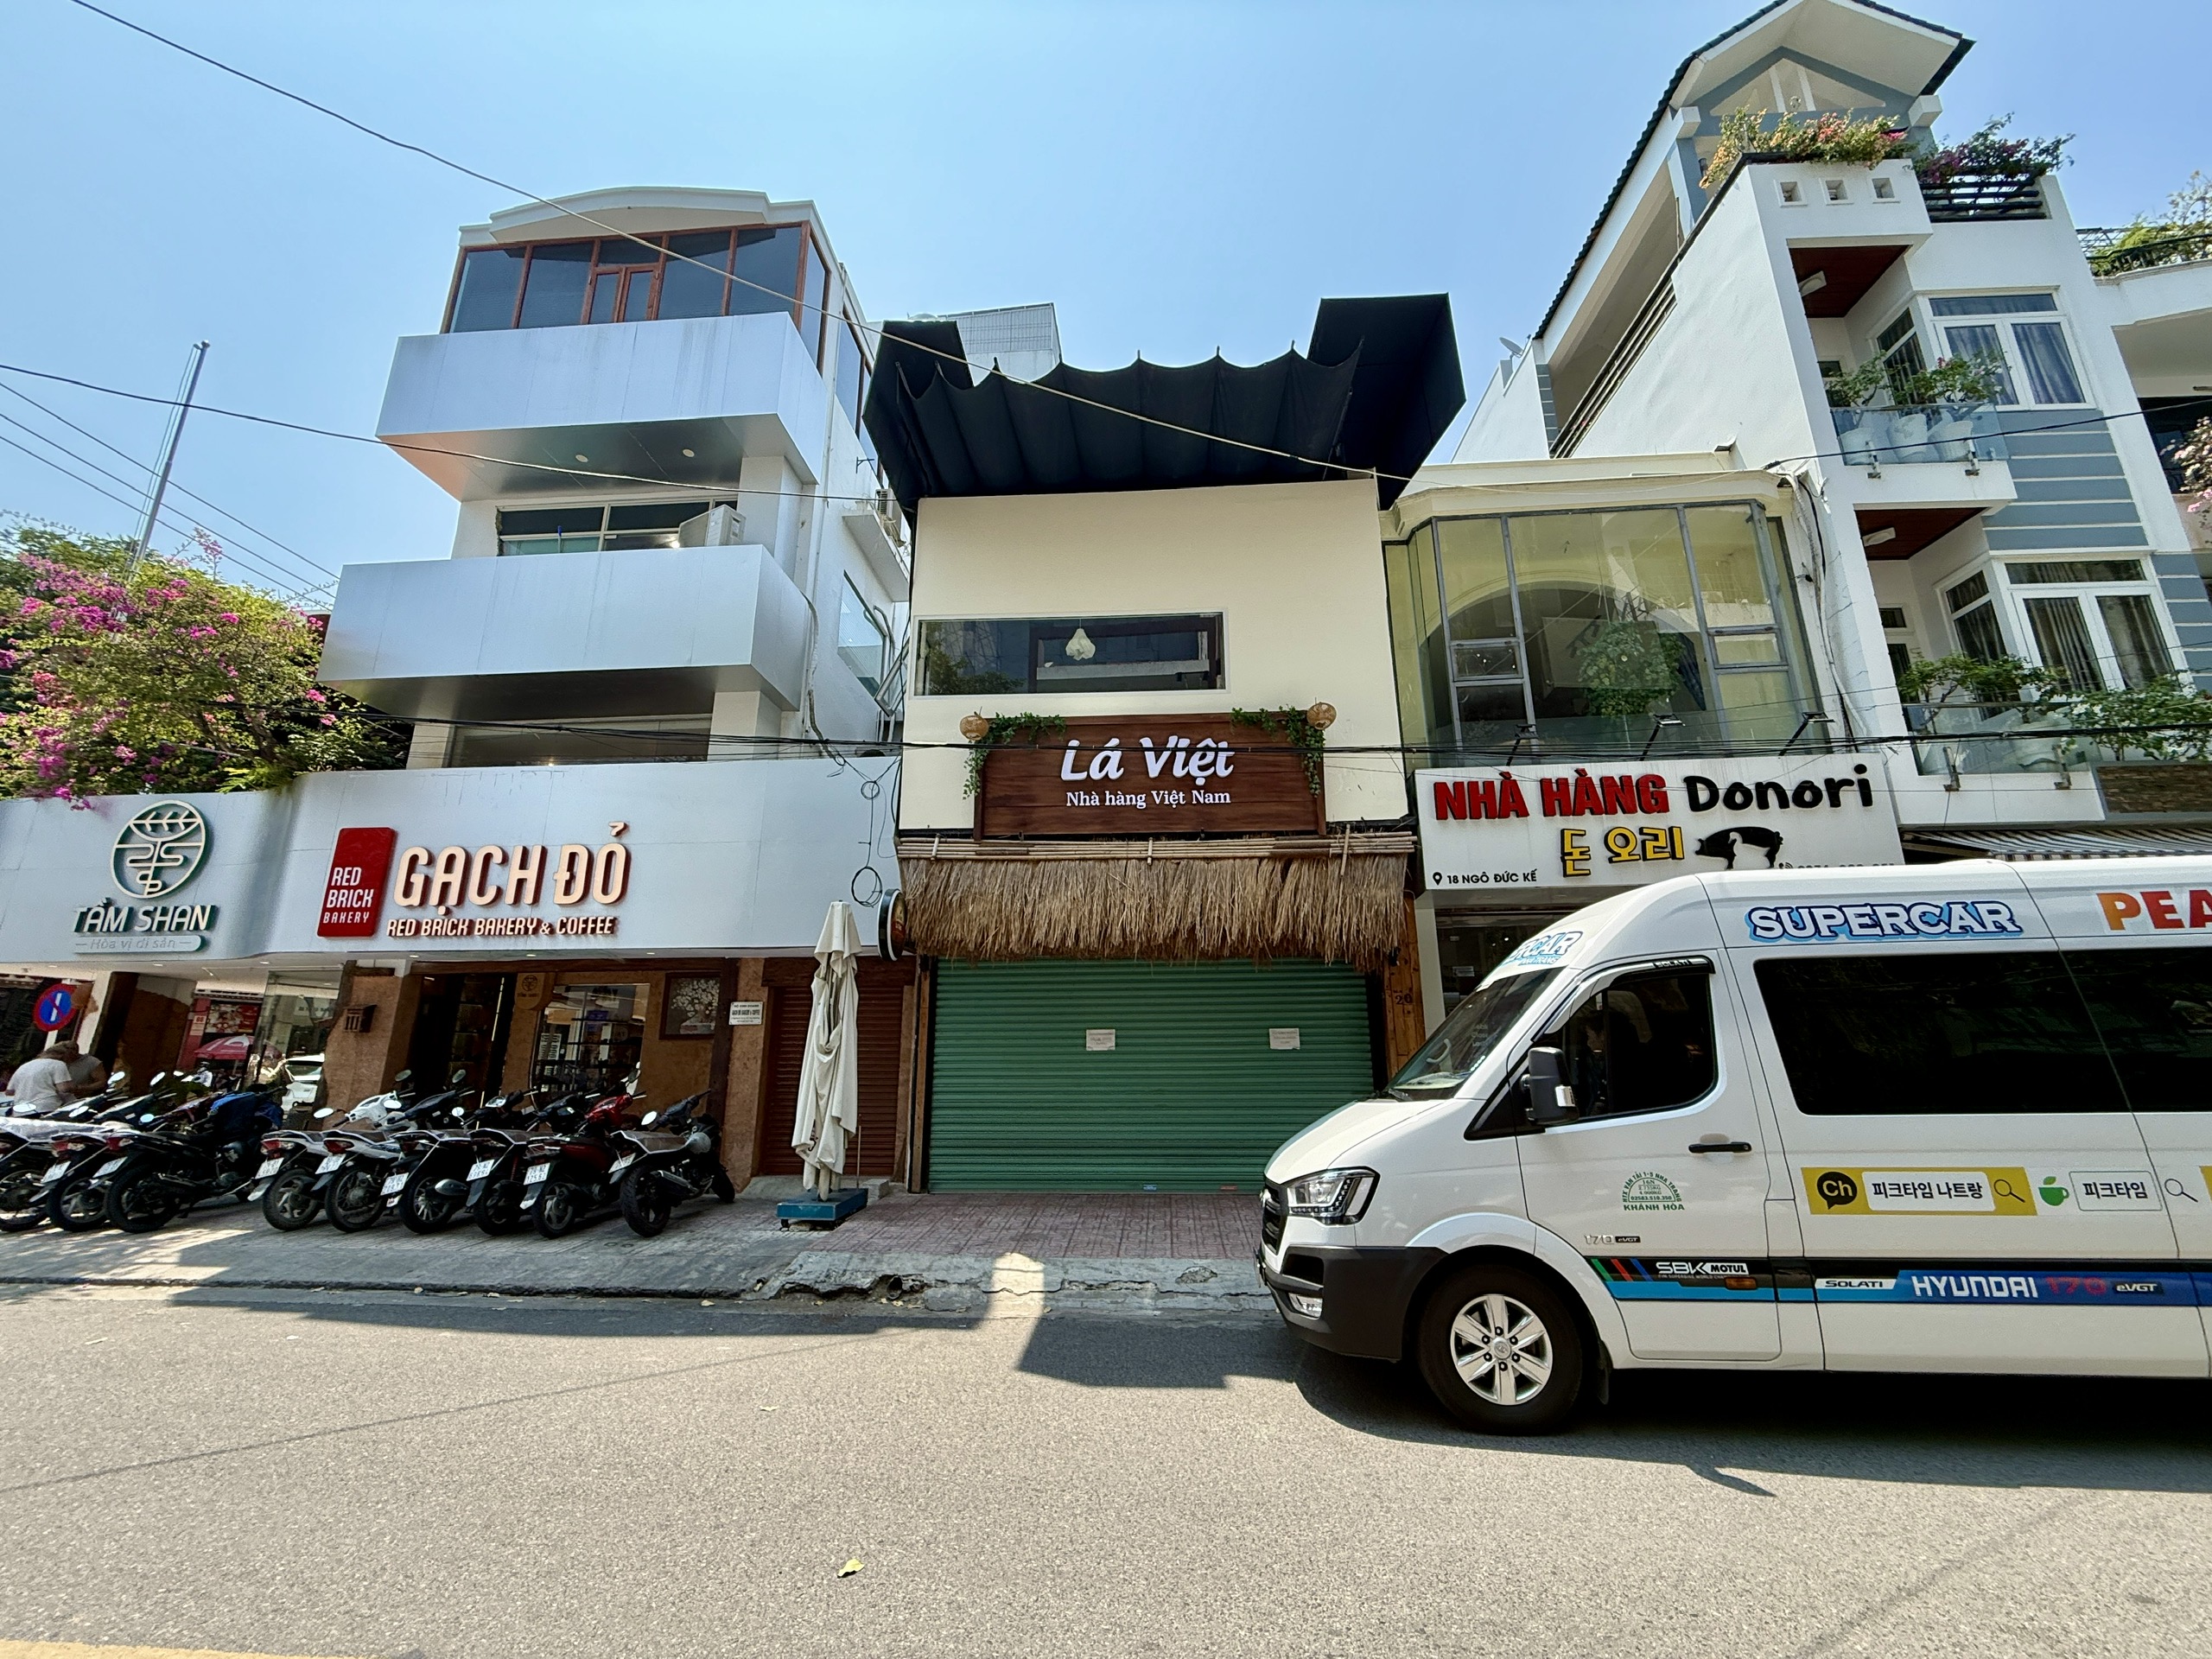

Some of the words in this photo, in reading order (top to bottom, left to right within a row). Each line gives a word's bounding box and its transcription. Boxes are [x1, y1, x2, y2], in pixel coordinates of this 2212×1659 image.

[1060, 737, 1124, 782] Lá
[1139, 735, 1236, 785] Việt
[1066, 790, 1100, 807] Nhà
[1104, 790, 1147, 809] hàng
[1151, 790, 1186, 809] Việt
[1192, 790, 1231, 804] Nam
[1433, 772, 1530, 821] NHÀ
[1540, 767, 1671, 817] HÀNG
[1683, 764, 1874, 813] Donori
[1560, 827, 1592, 878] 돈
[1604, 826, 1686, 864] 오리
[331, 867, 362, 886] RED
[393, 845, 545, 917] GẠCH
[553, 822, 631, 906] ĐỎ
[1447, 874, 1459, 884] 18
[1462, 871, 1490, 883] NGÔ
[1493, 870, 1519, 883] ĐỨC
[1522, 868, 1538, 882] KẾ
[326, 889, 374, 909] BRICK
[135, 905, 213, 932] SHAN
[322, 912, 370, 924] BAKERY
[387, 918, 415, 937] RED
[420, 918, 470, 936] BRICK
[474, 918, 537, 936] BAKERY
[540, 921, 552, 935] &
[556, 917, 616, 935] COFFEE
[1746, 901, 2024, 941] SUPERCAR
[90, 938, 116, 950] Hòa
[1822, 1179, 1853, 1198] Ch
[1872, 1182, 1933, 1199] 피크타임
[1937, 1182, 1983, 1199] 나트랑
[2084, 1182, 2148, 1199] 피크타임
[1656, 1262, 1707, 1274] SBK
[1710, 1263, 1747, 1274] MOTUL
[1825, 1280, 1884, 1288] SOLATI
[1911, 1275, 2039, 1298] HYUNDAI
[2046, 1277, 2107, 1295] 170
[2115, 1283, 2158, 1294] eVGT
